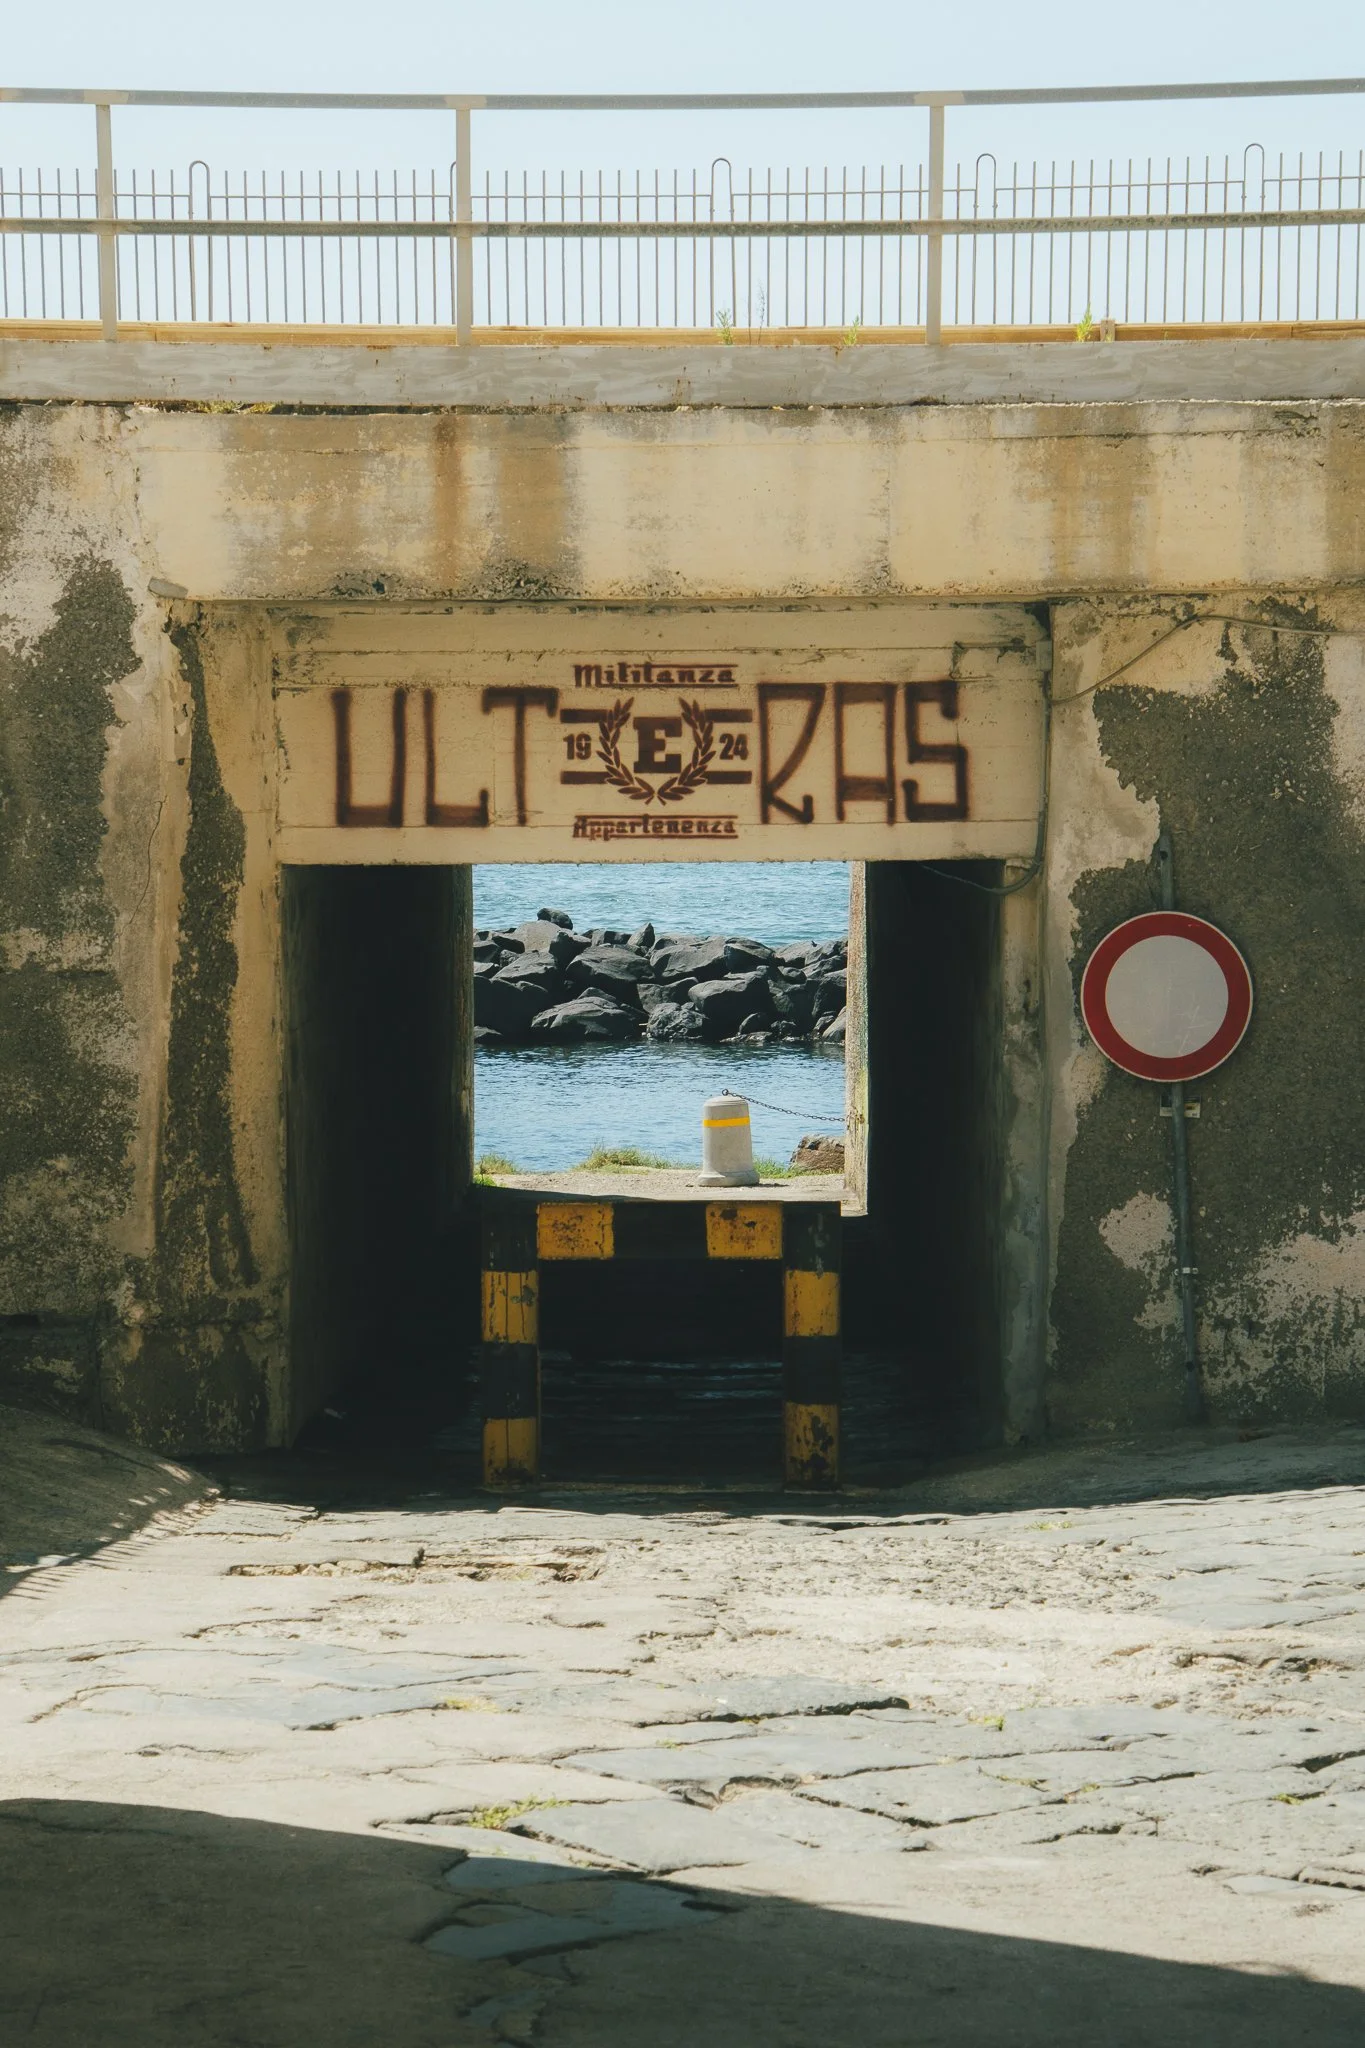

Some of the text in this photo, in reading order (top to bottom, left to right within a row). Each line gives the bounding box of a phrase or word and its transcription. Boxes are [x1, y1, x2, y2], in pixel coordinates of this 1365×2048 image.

[563, 733, 592, 760] 19
[633, 716, 682, 773] E
[719, 733, 749, 760] 24
[572, 814, 737, 841] Appartenenza
